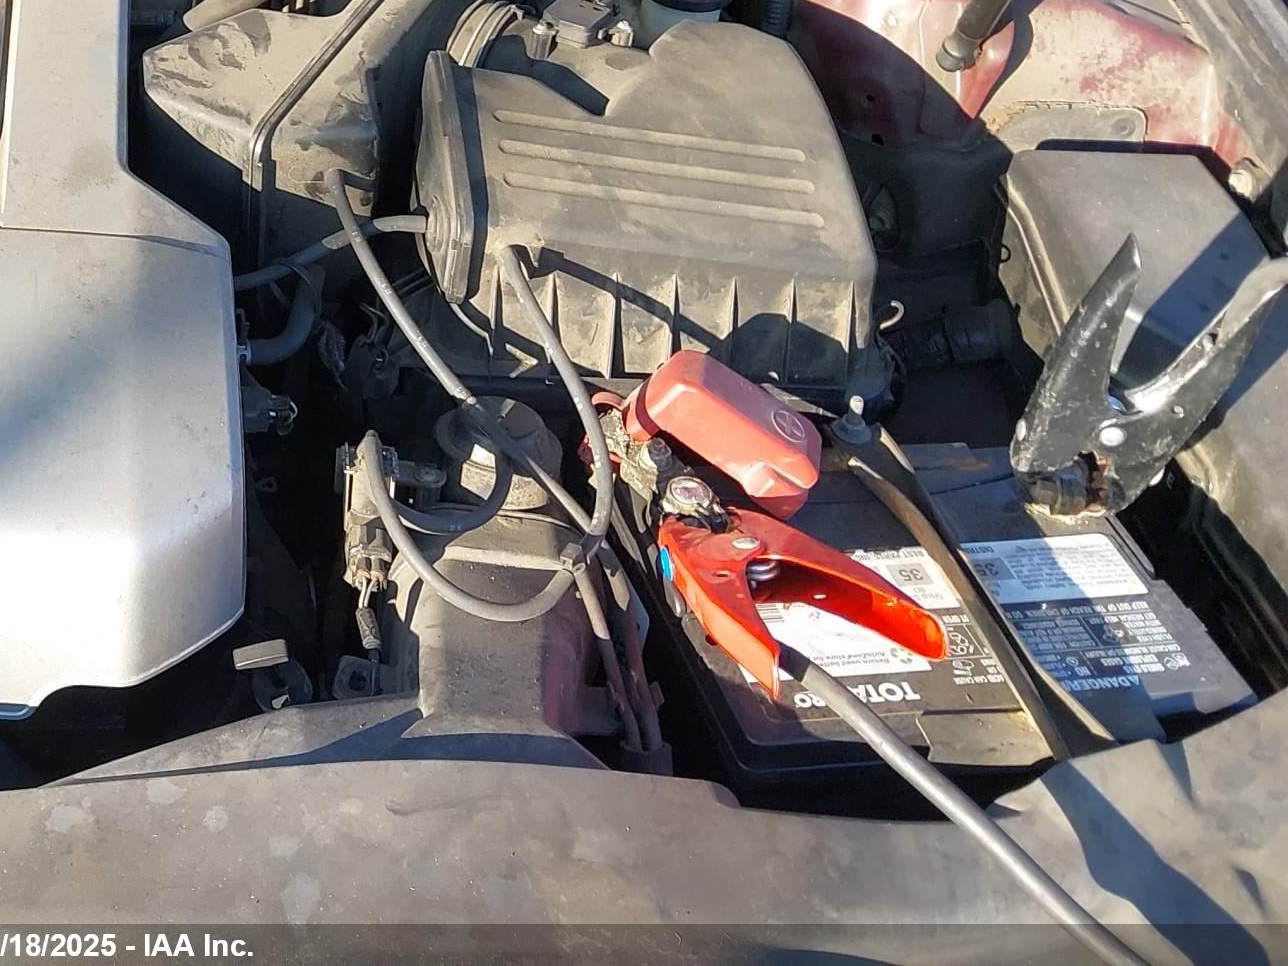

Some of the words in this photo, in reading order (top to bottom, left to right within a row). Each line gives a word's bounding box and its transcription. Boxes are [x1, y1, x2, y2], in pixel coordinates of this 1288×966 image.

[898, 568, 924, 582] 35
[975, 563, 1000, 577] 35
[1074, 665, 1092, 677] NO
